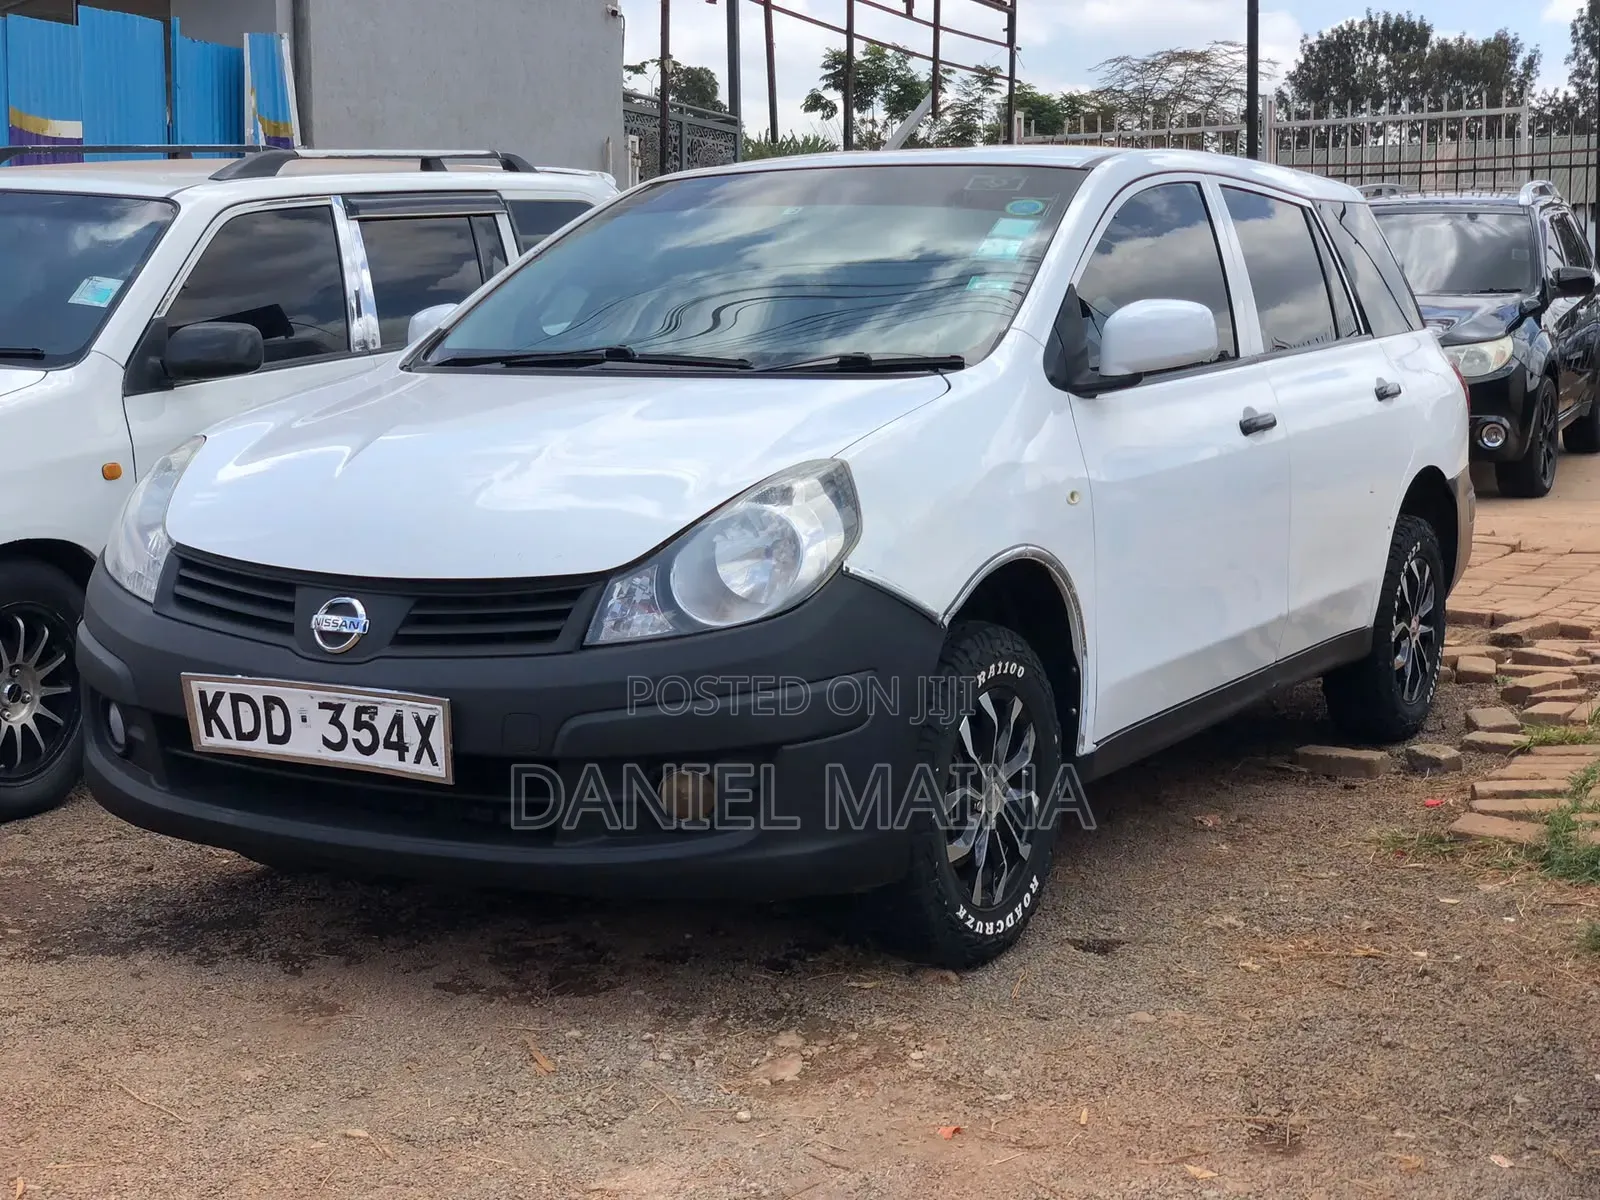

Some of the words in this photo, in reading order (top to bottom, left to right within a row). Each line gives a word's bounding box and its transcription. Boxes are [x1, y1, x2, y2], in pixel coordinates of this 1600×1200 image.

[314, 617, 360, 630] NISSAN
[976, 660, 1025, 689] RA1100
[198, 690, 292, 745] KDD
[318, 701, 439, 766] 354X
[955, 874, 1040, 935] ROADCRUZA
